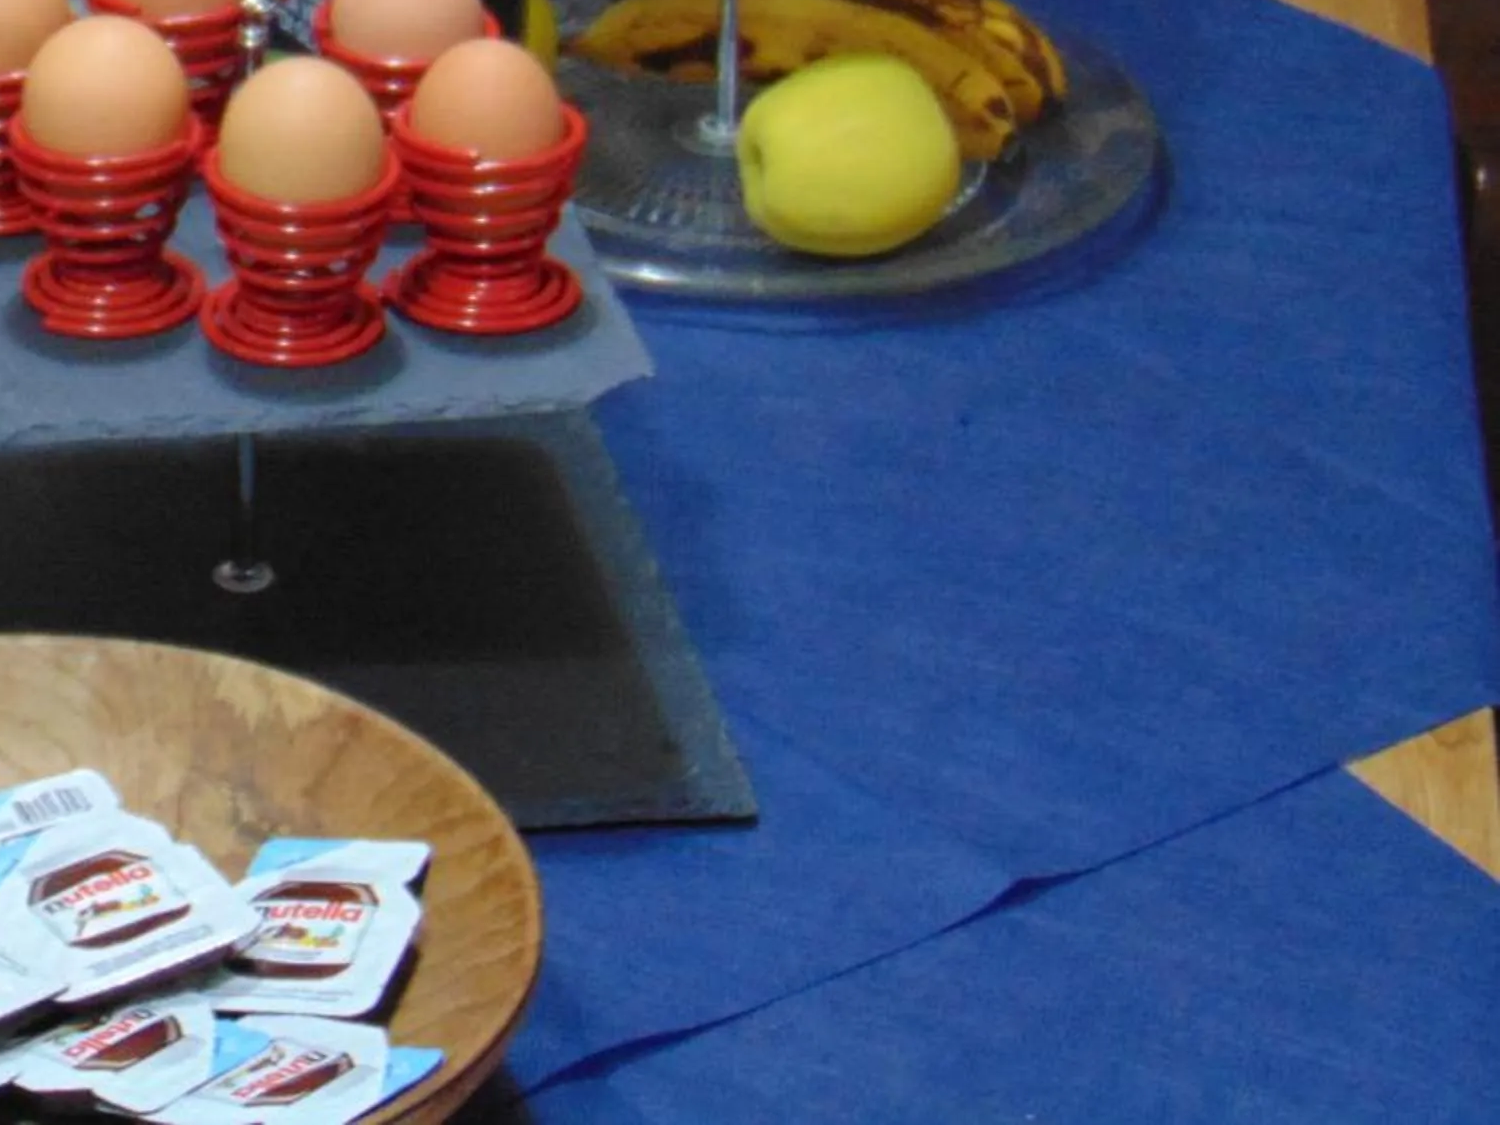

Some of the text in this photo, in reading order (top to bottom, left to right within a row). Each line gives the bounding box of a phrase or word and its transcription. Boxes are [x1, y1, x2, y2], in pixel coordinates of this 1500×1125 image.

[44, 866, 152, 913] nutella
[64, 1007, 157, 1056] nutella
[230, 1050, 327, 1097] nutella
